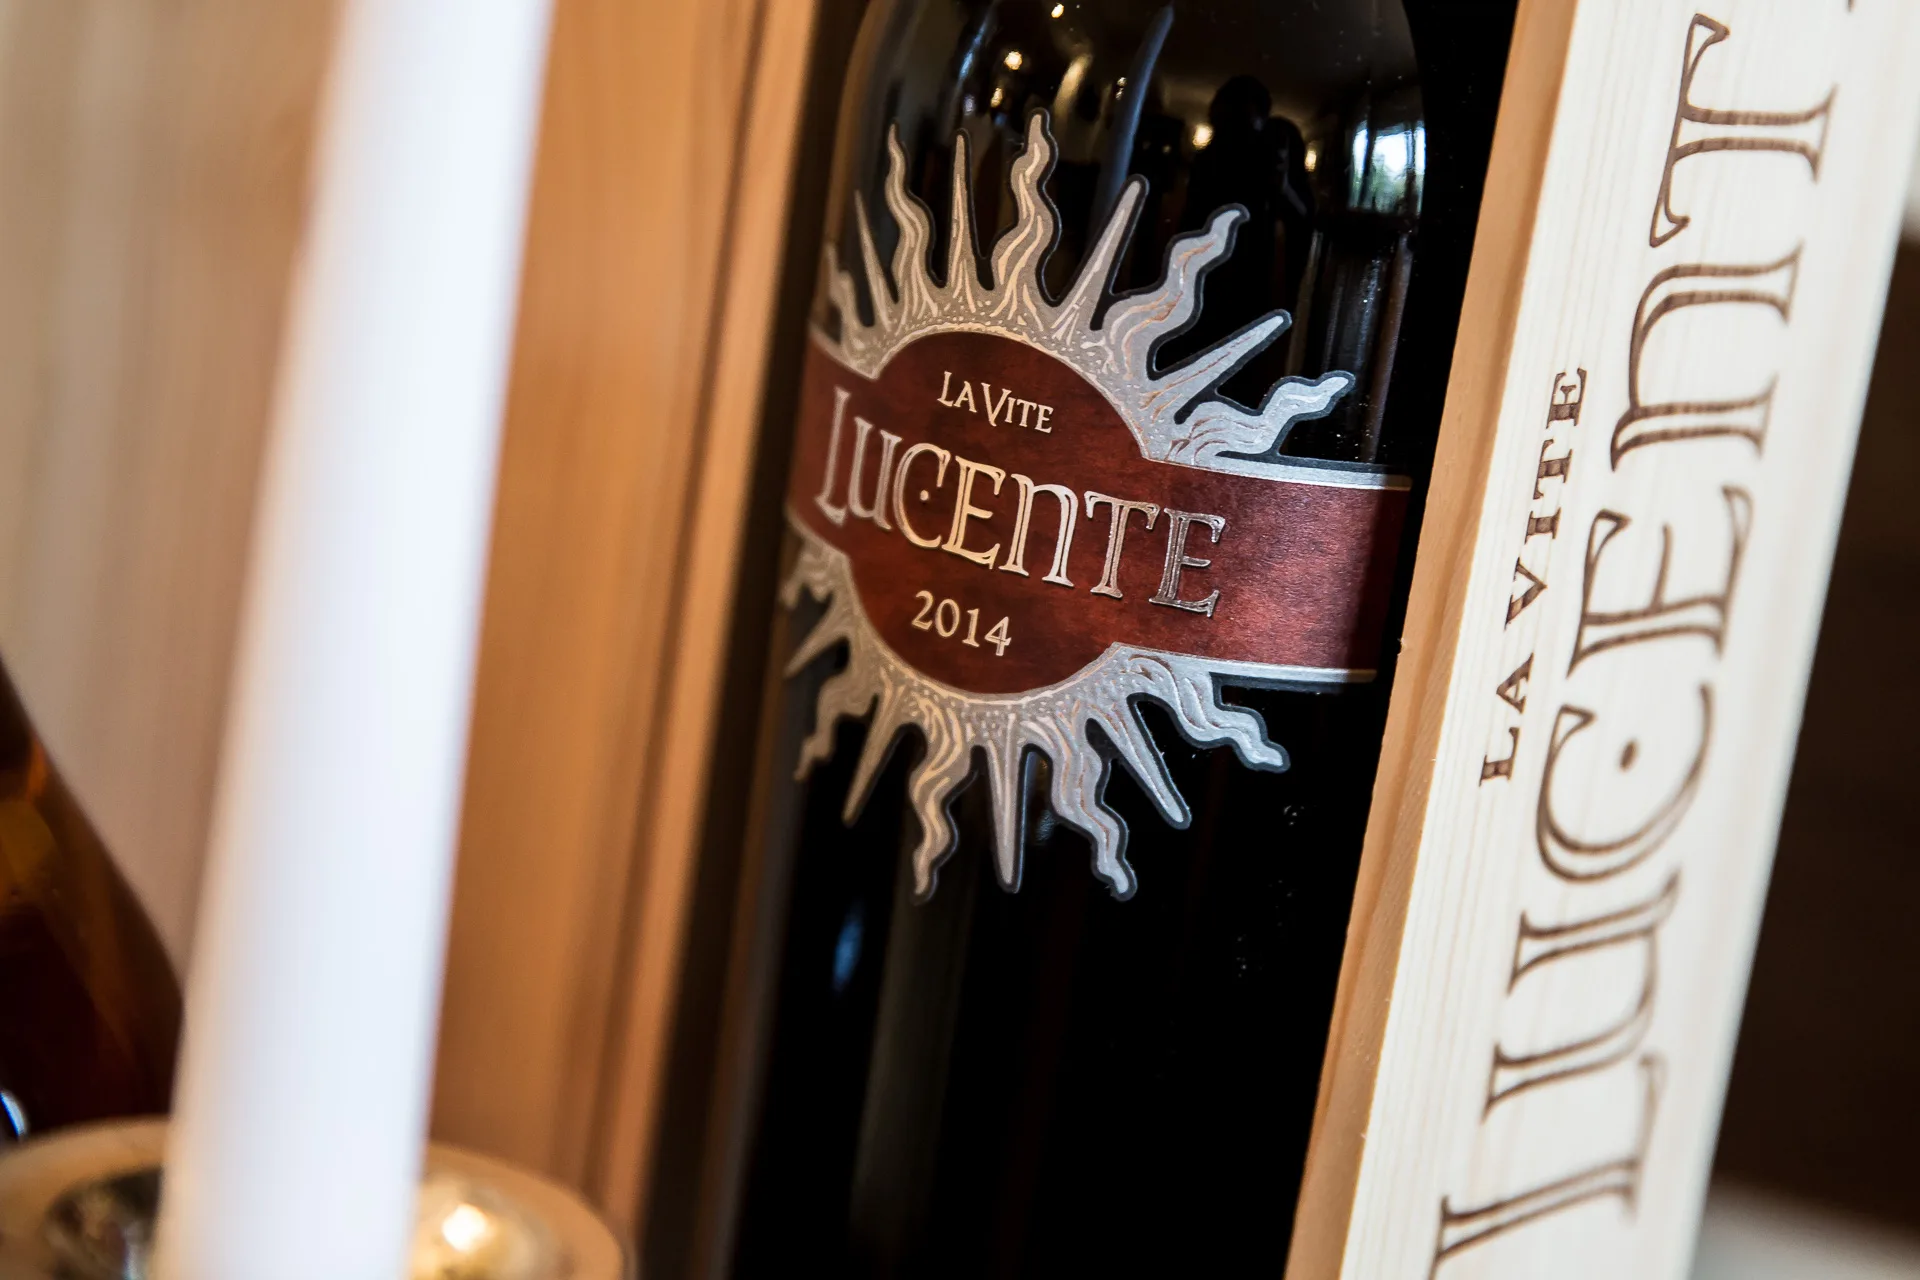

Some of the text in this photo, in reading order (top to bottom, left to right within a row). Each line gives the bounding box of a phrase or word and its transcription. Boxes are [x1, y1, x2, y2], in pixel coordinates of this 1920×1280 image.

[814, 386, 1226, 618] LUCENTE
[911, 590, 1012, 656] 2014
[1426, 0, 1855, 1280] LUCENT
[1479, 367, 1587, 787] LA VITE
